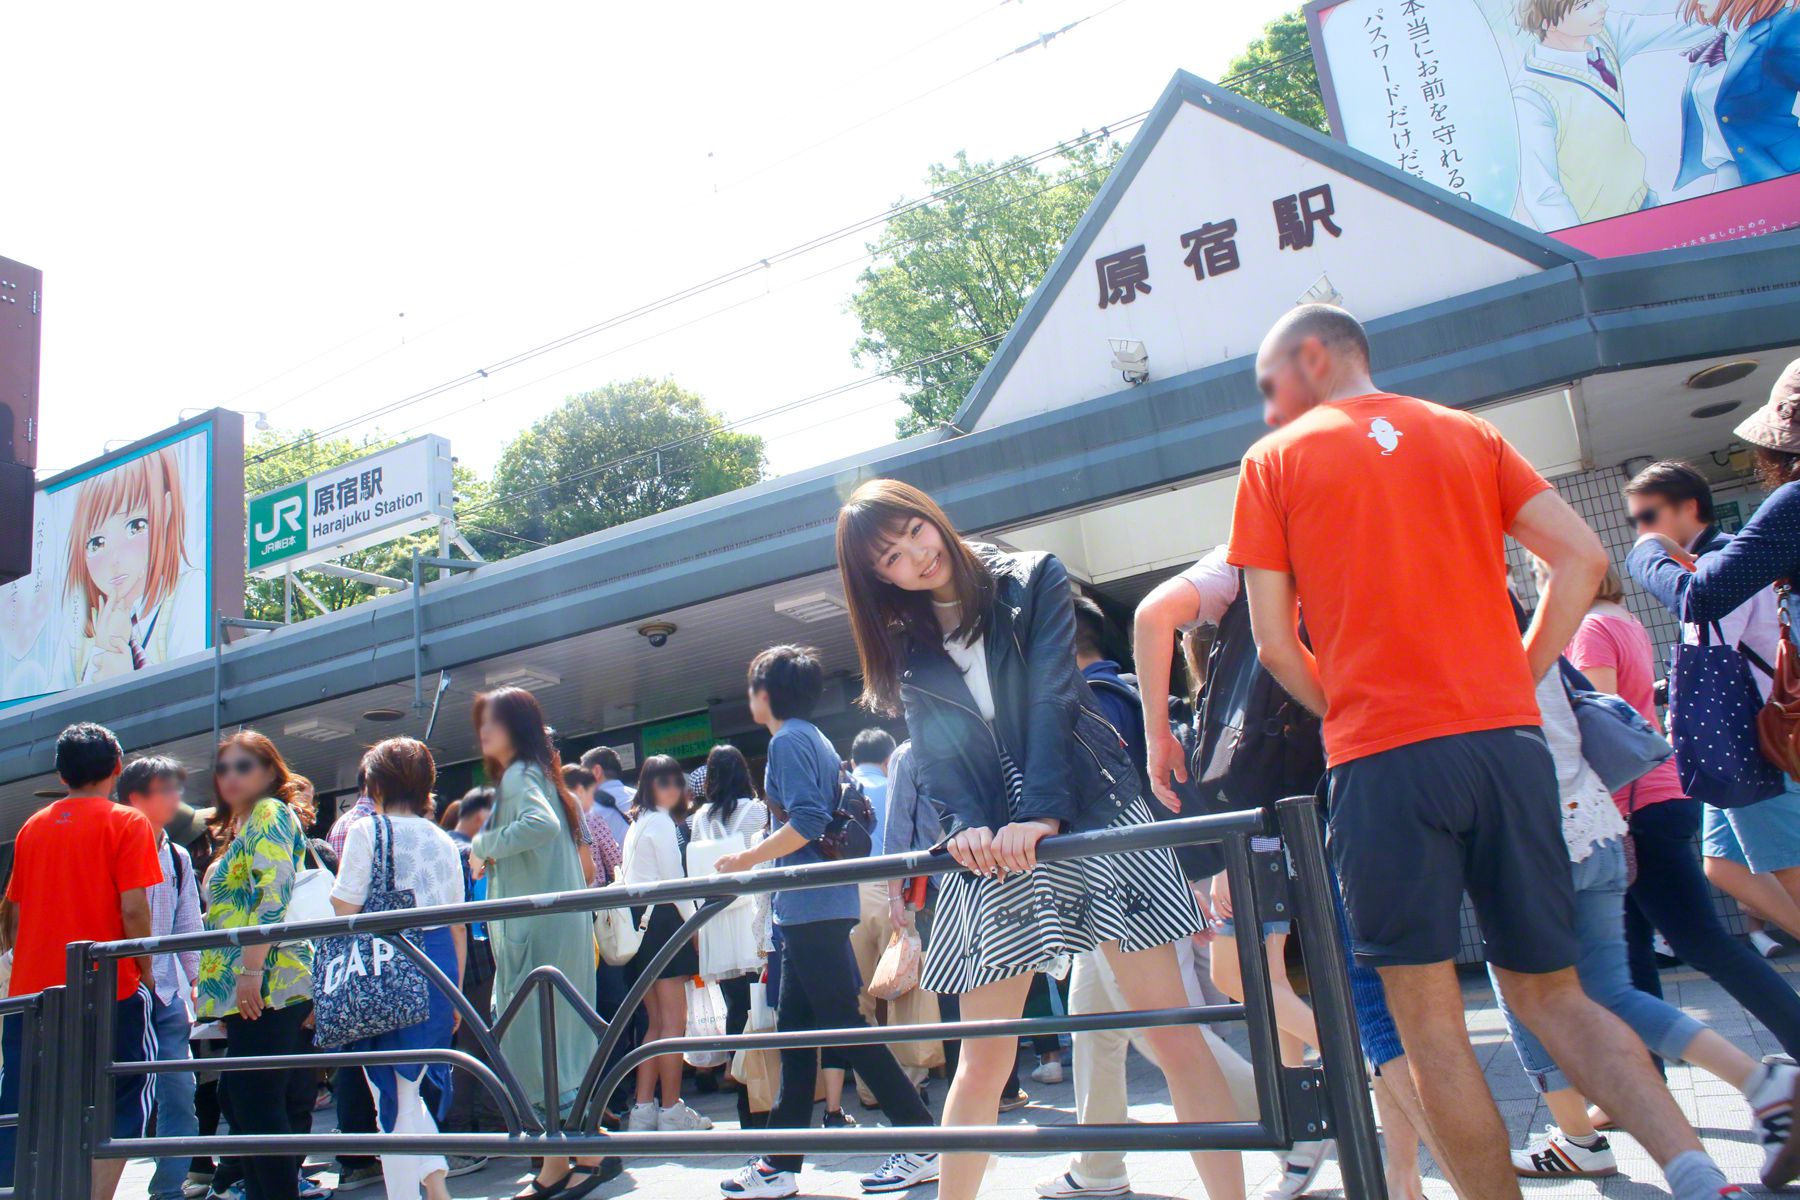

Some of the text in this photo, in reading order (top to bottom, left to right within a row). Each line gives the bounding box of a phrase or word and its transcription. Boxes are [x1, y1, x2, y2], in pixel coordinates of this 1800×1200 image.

[1364, 8, 1423, 178] パスワードだけだ
[1095, 183, 1342, 309] 原宿駅
[312, 491, 423, 538] Harajuku Station
[313, 466, 383, 518] 原宿駅
[255, 495, 303, 543] JR
[261, 535, 297, 556] JR東日本
[323, 937, 394, 995] GAP
